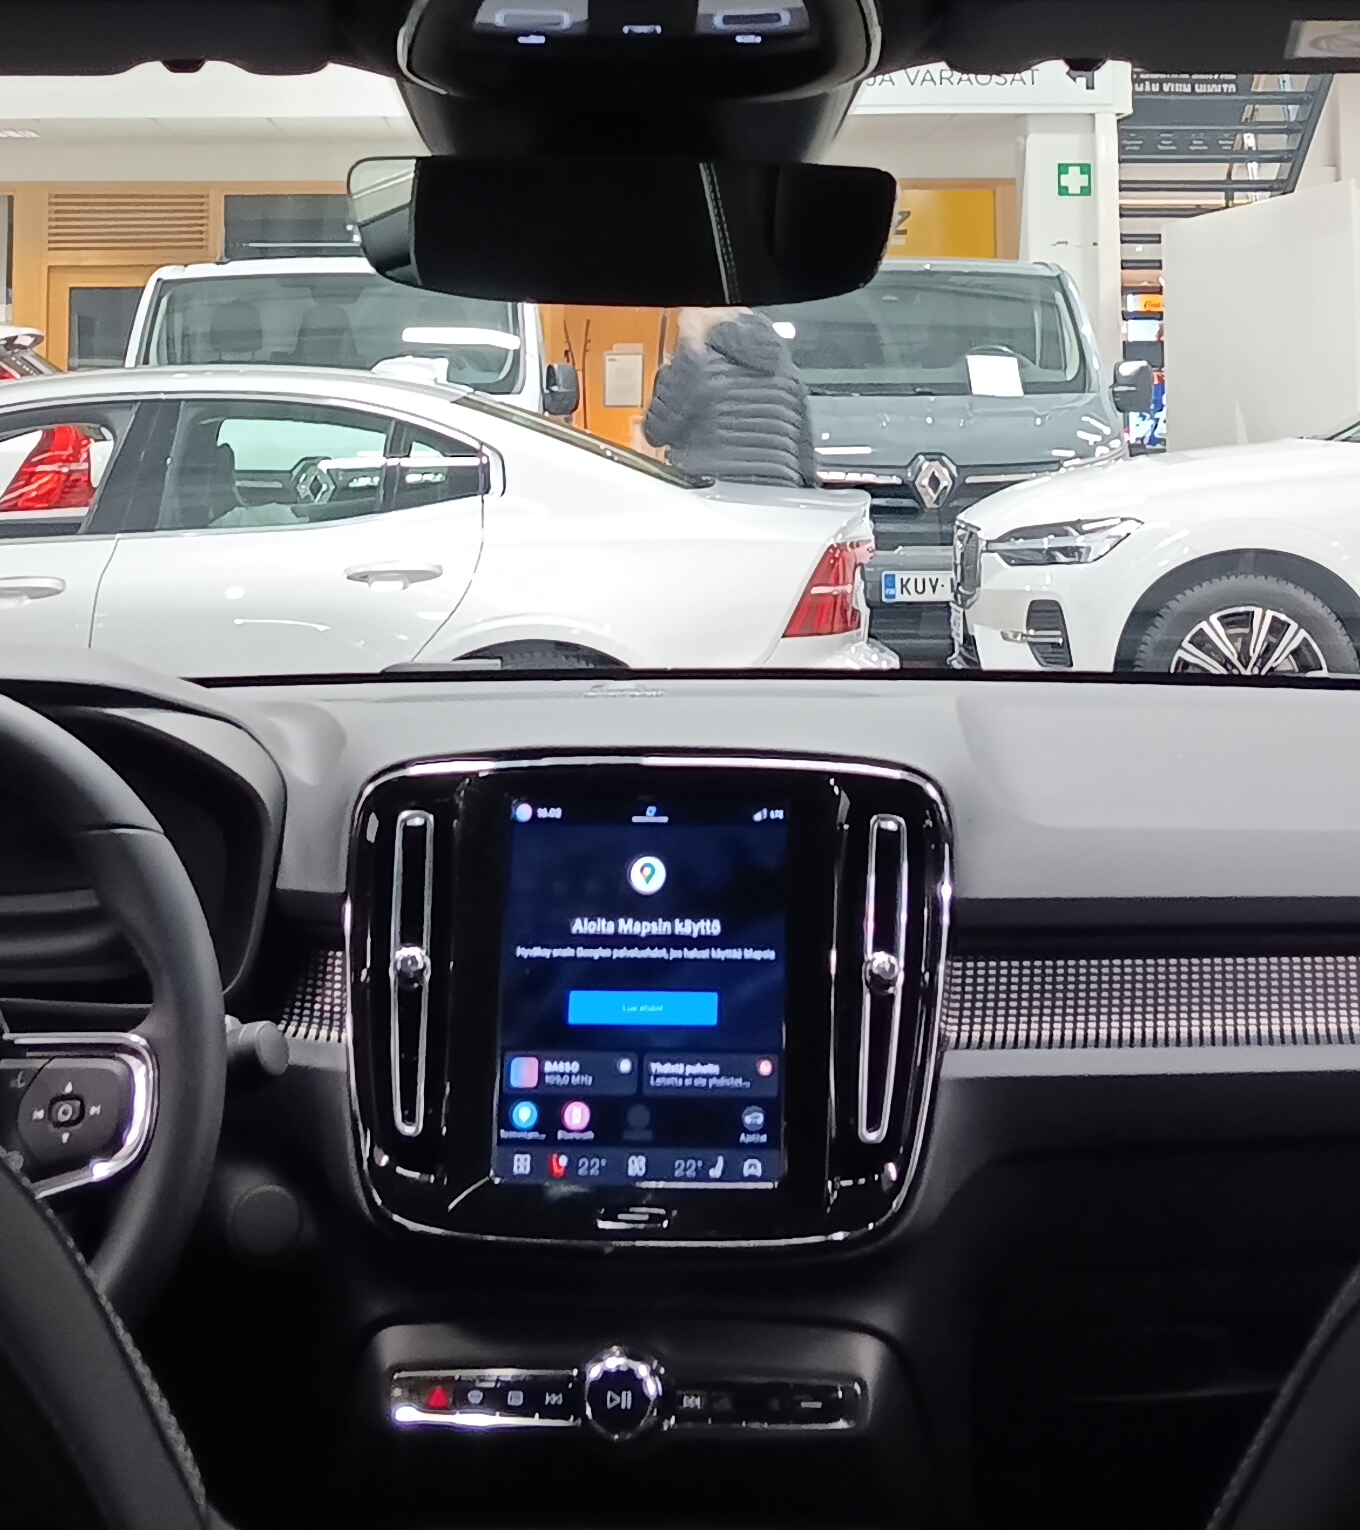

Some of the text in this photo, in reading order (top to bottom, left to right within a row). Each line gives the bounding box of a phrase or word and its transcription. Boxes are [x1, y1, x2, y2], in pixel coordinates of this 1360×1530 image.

[904, 69, 1039, 86] VARAOSAT
[571, 918, 721, 938] Aloita Mapsin käyttö
